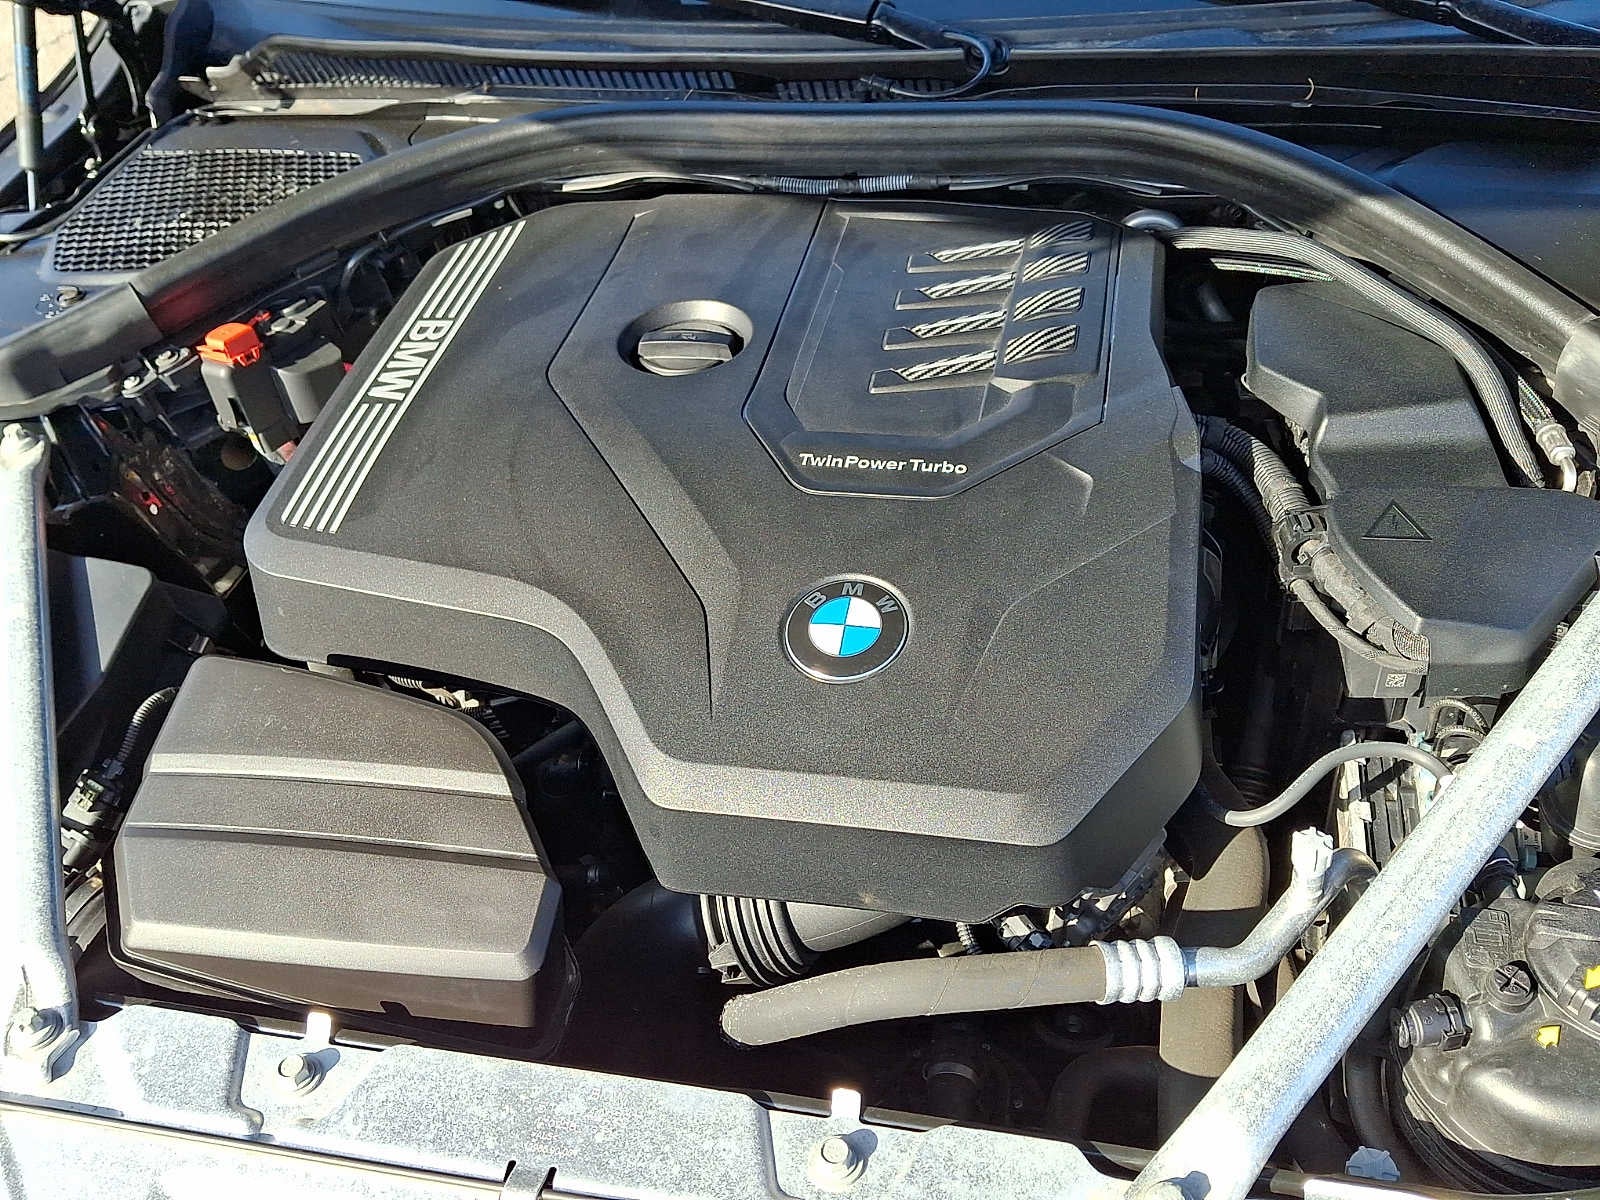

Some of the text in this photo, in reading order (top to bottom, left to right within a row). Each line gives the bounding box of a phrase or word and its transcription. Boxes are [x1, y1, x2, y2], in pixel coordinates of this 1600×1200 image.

[367, 320, 455, 401] BMW
[800, 453, 968, 475] TwinPower Turbo
[803, 582, 899, 614] BMW
